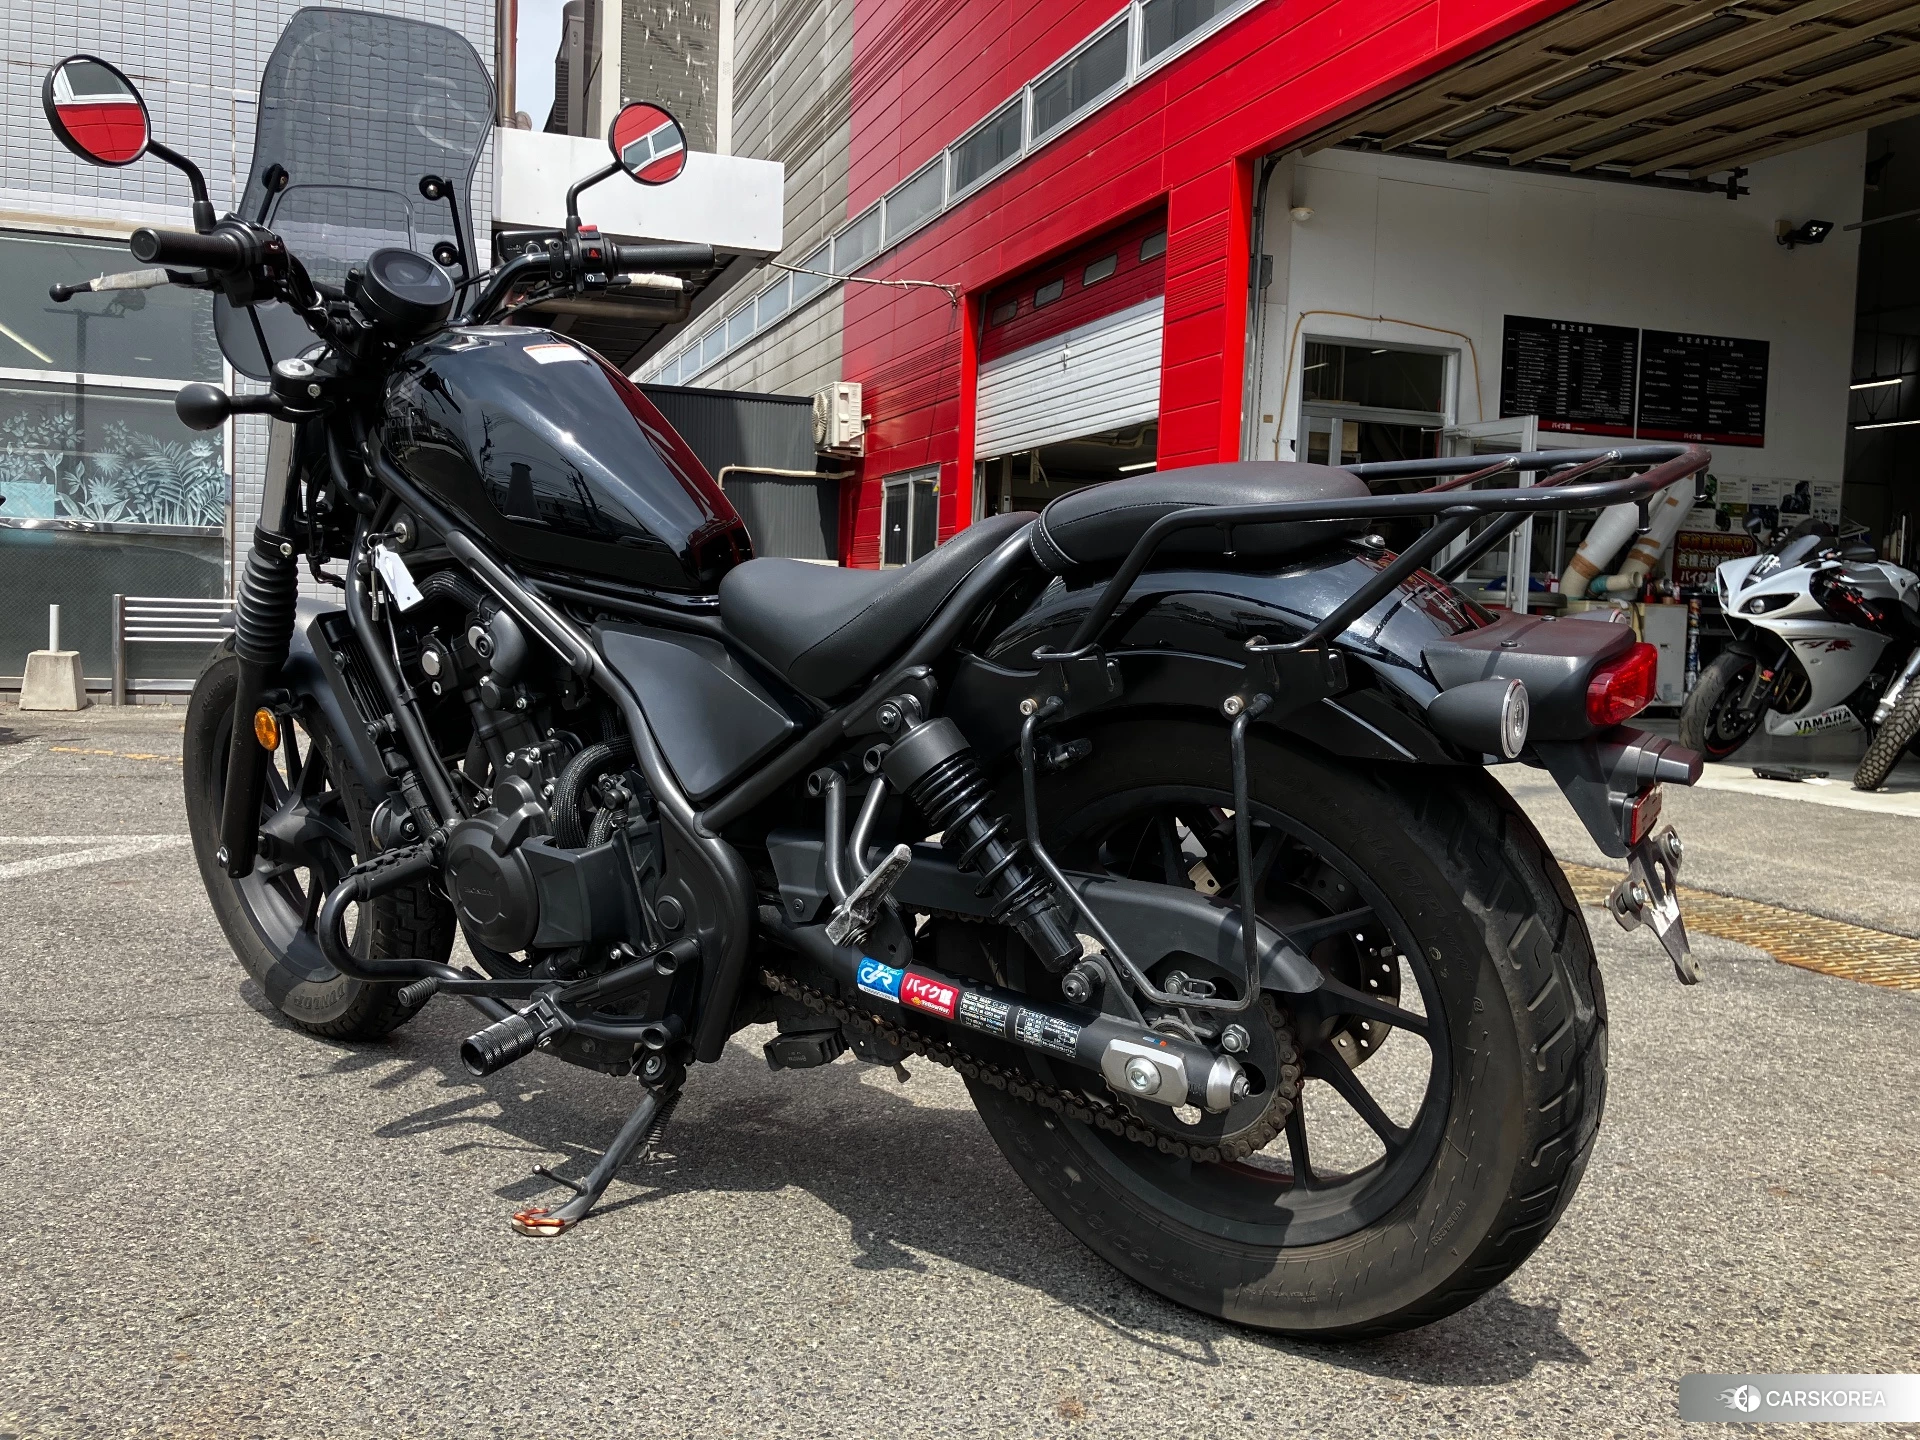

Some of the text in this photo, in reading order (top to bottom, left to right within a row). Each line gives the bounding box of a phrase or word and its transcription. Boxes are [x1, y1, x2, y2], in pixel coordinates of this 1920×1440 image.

[384, 415, 423, 429] HONDA
[1794, 711, 1851, 731] YAMAHA
[906, 977, 954, 1006] バイク館
[1431, 1199, 1467, 1247] TUBELESS
